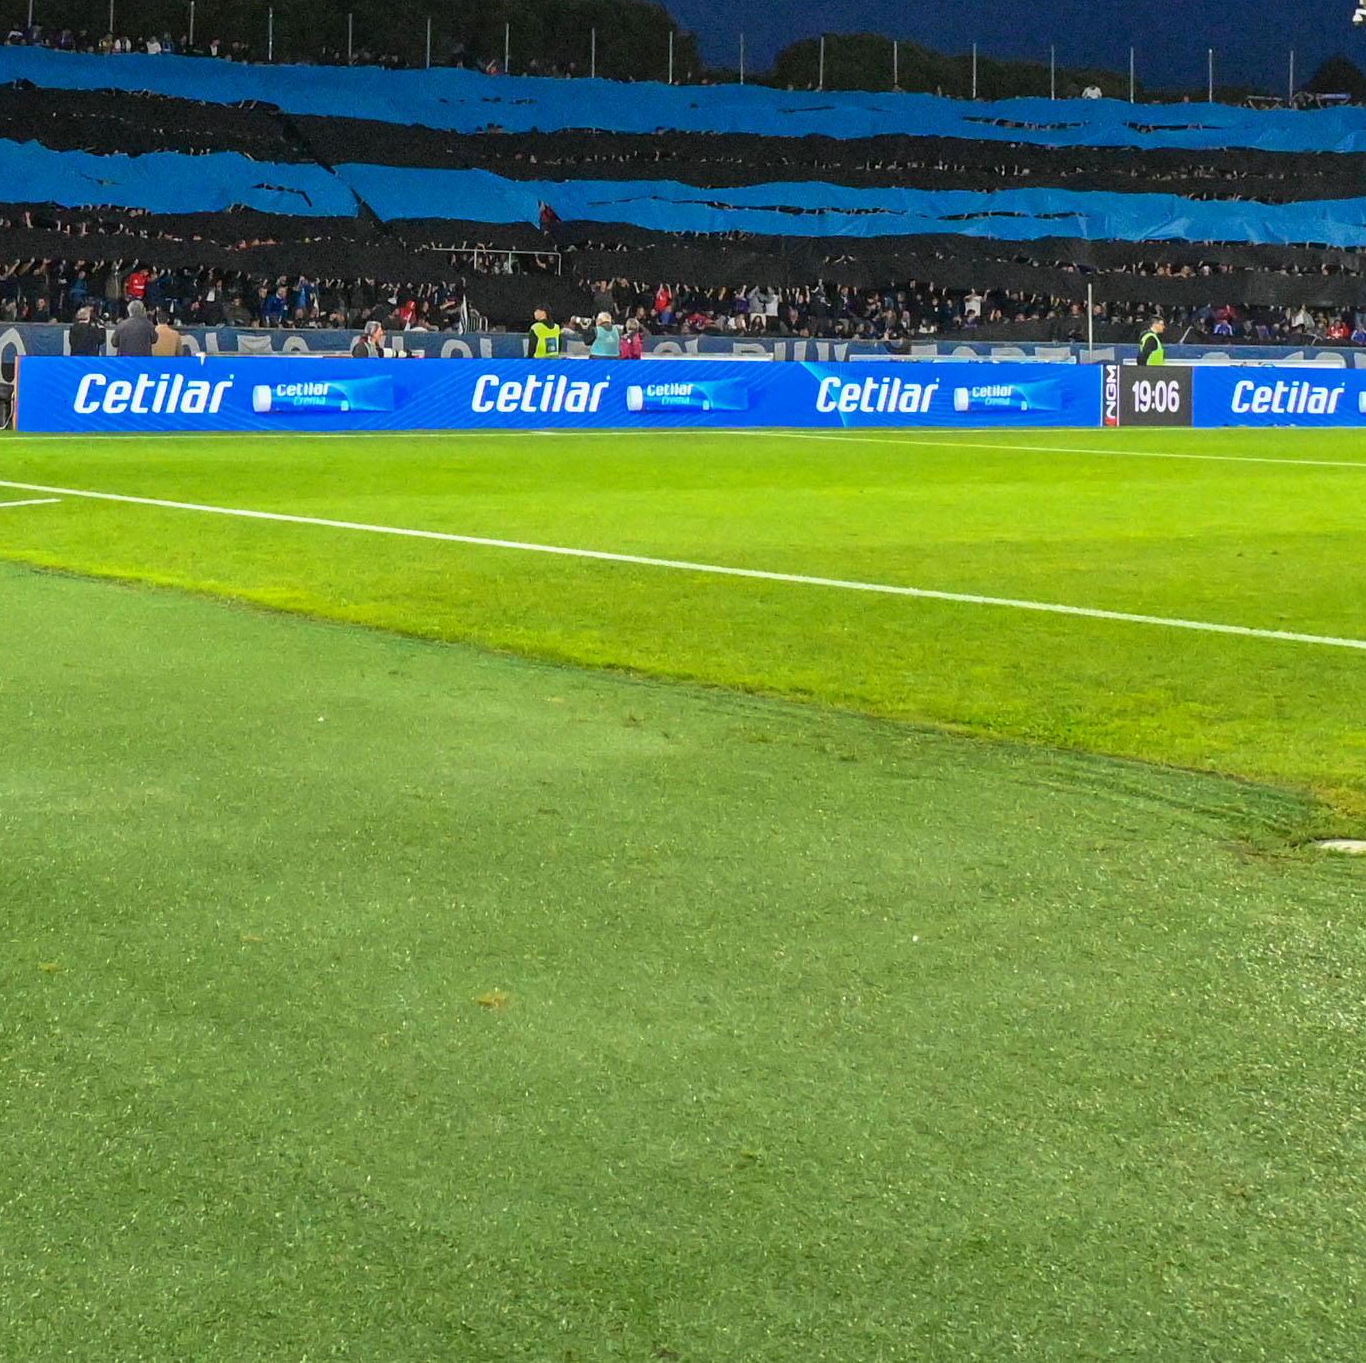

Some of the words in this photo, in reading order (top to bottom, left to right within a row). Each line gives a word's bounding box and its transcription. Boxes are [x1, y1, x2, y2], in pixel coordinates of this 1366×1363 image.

[73, 374, 232, 414] Cetilar
[276, 382, 330, 396] Cetilar
[472, 375, 610, 413] Cetilar
[647, 383, 694, 395] Cetilar
[816, 377, 938, 413] Cetilar
[972, 385, 1013, 397] Cetilar
[1132, 380, 1179, 414] 19:06
[1231, 380, 1345, 414] Cetilar
